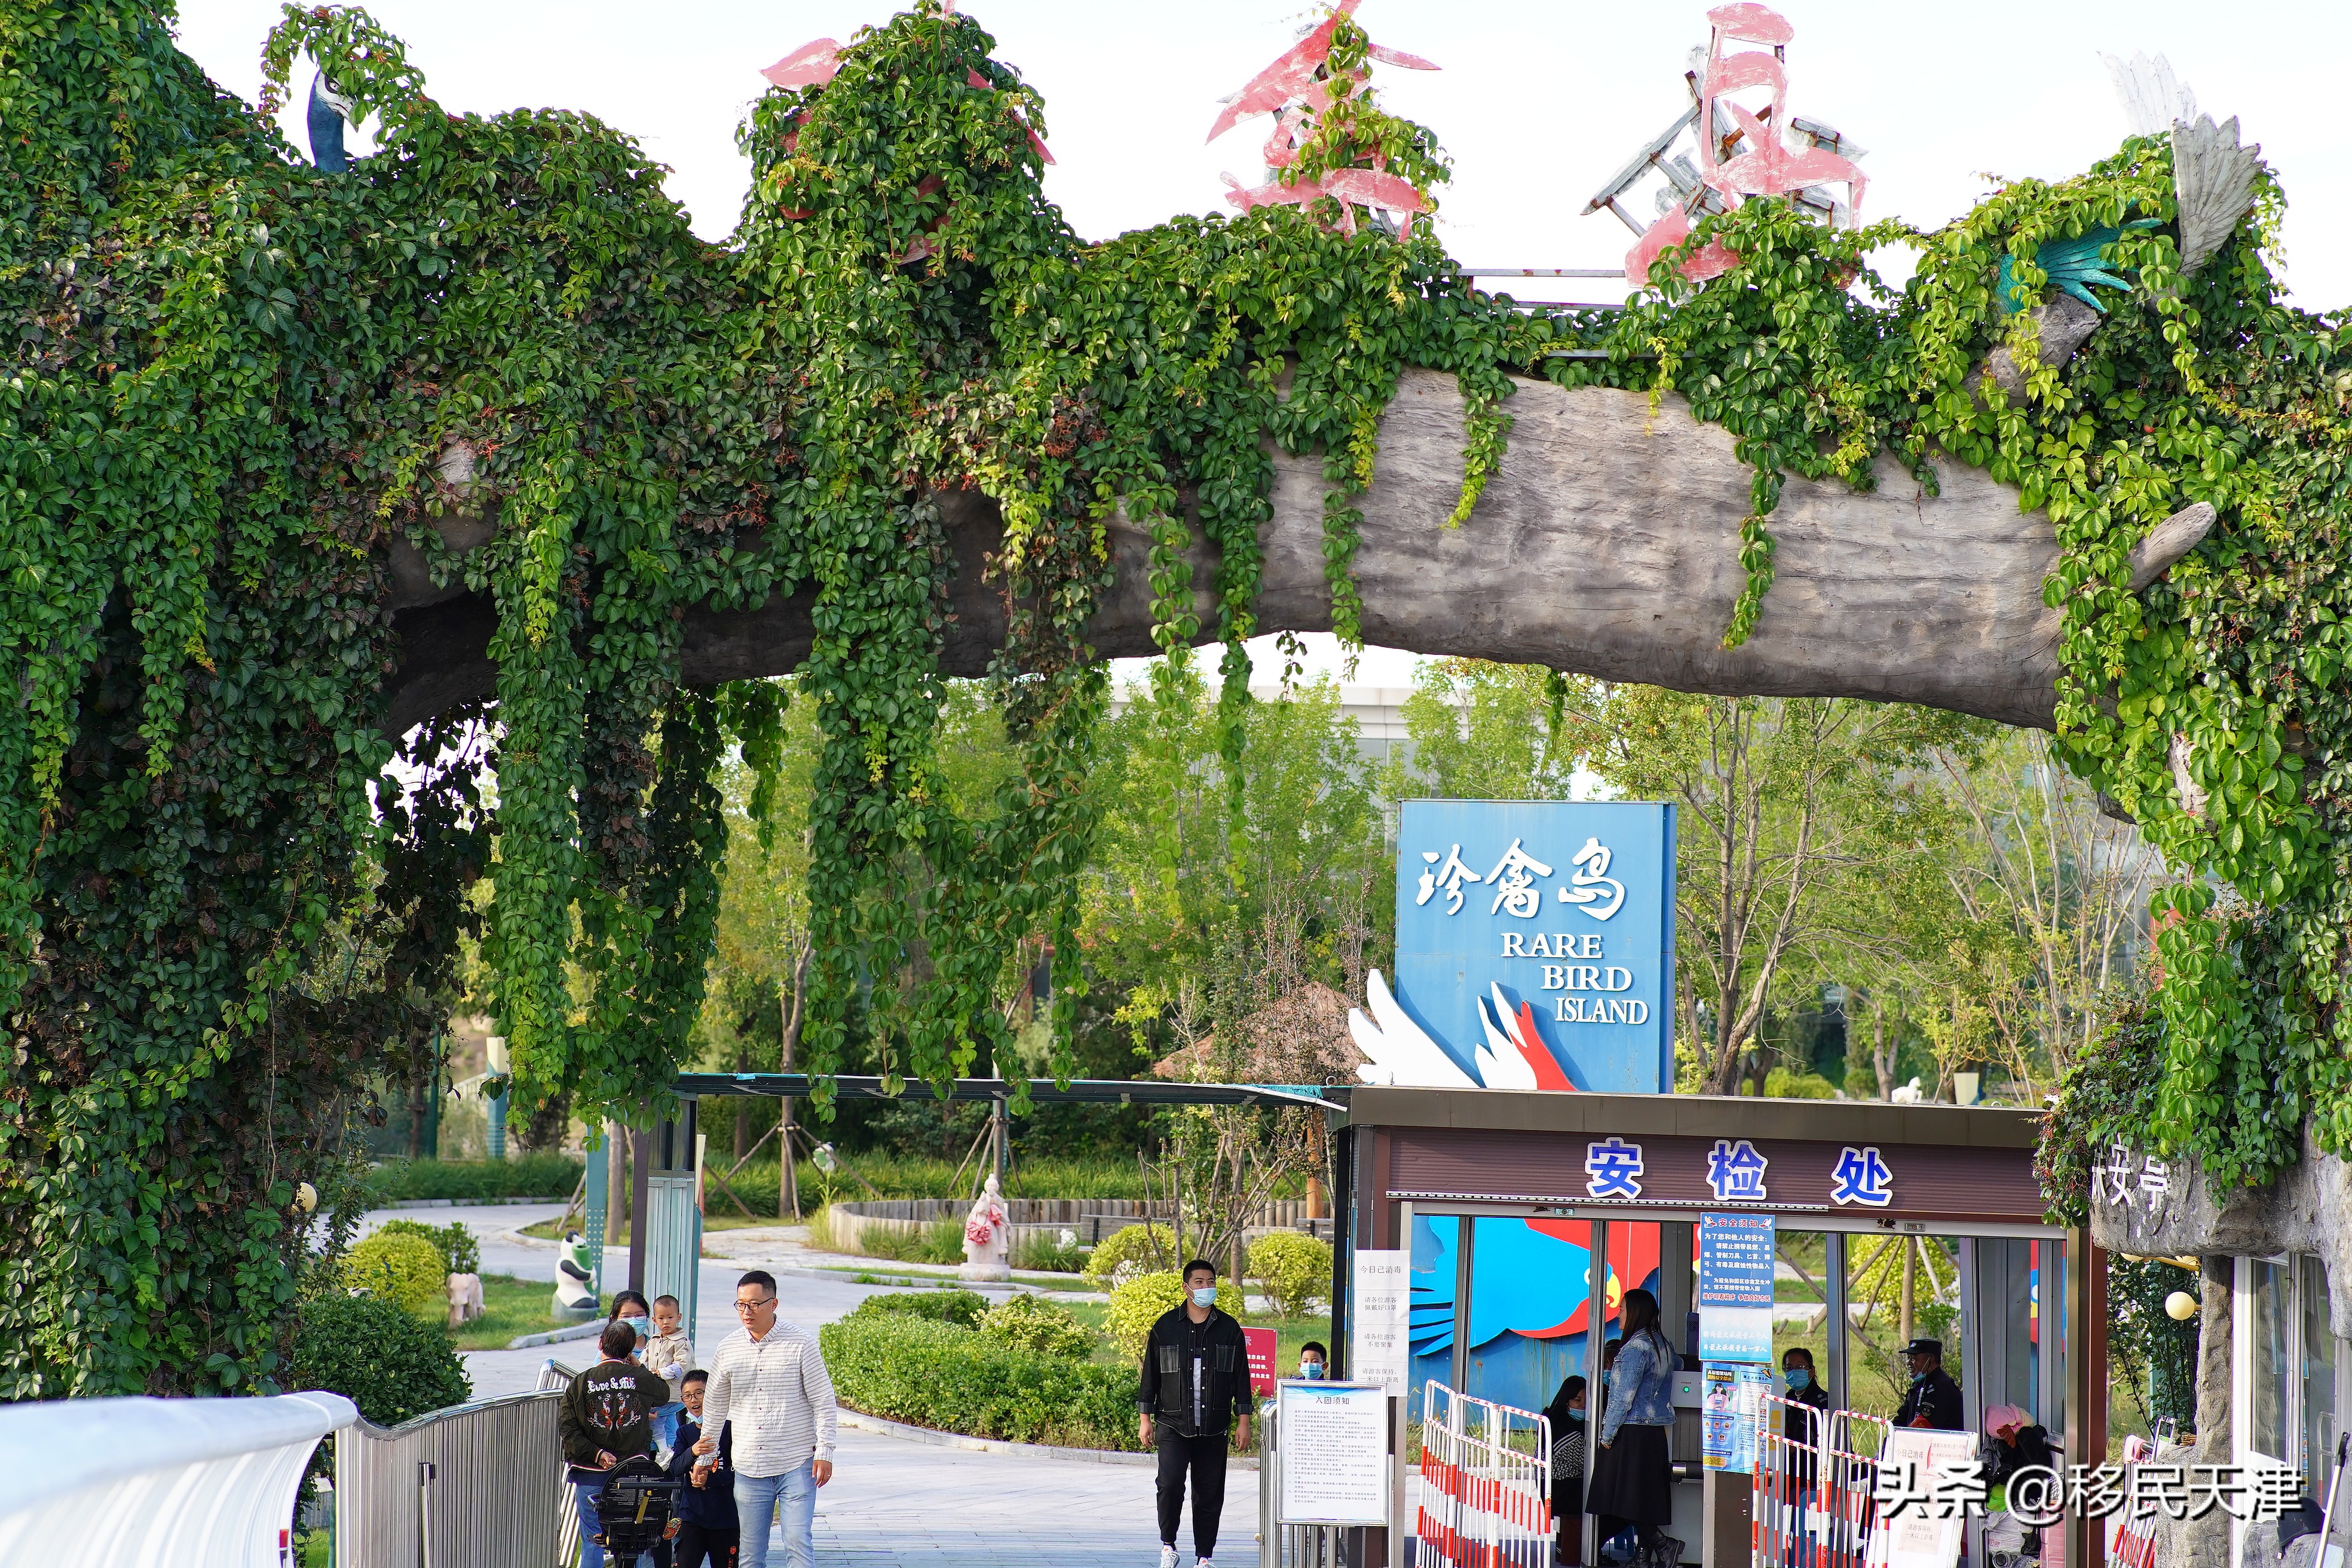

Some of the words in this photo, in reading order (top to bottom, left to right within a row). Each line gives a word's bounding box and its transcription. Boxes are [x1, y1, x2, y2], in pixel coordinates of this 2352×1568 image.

[1416, 837, 1625, 921] 珍禽岛
[1500, 933, 1603, 959] RARE
[1541, 965, 1632, 992] BIRD
[1555, 997, 1649, 1025] ISLAND
[1585, 1137, 1893, 1206] 安检处
[1719, 1218, 1758, 1228] 安全须知
[1704, 1233, 1768, 1242] 为了您和他人的安全：
[1360, 1265, 1402, 1274] 今日已消毒
[1315, 1396, 1350, 1405] 入园须知
[1896, 1448, 1924, 1459] 今日已消毒
[1906, 1533, 1934, 1541] 一米以上距离
